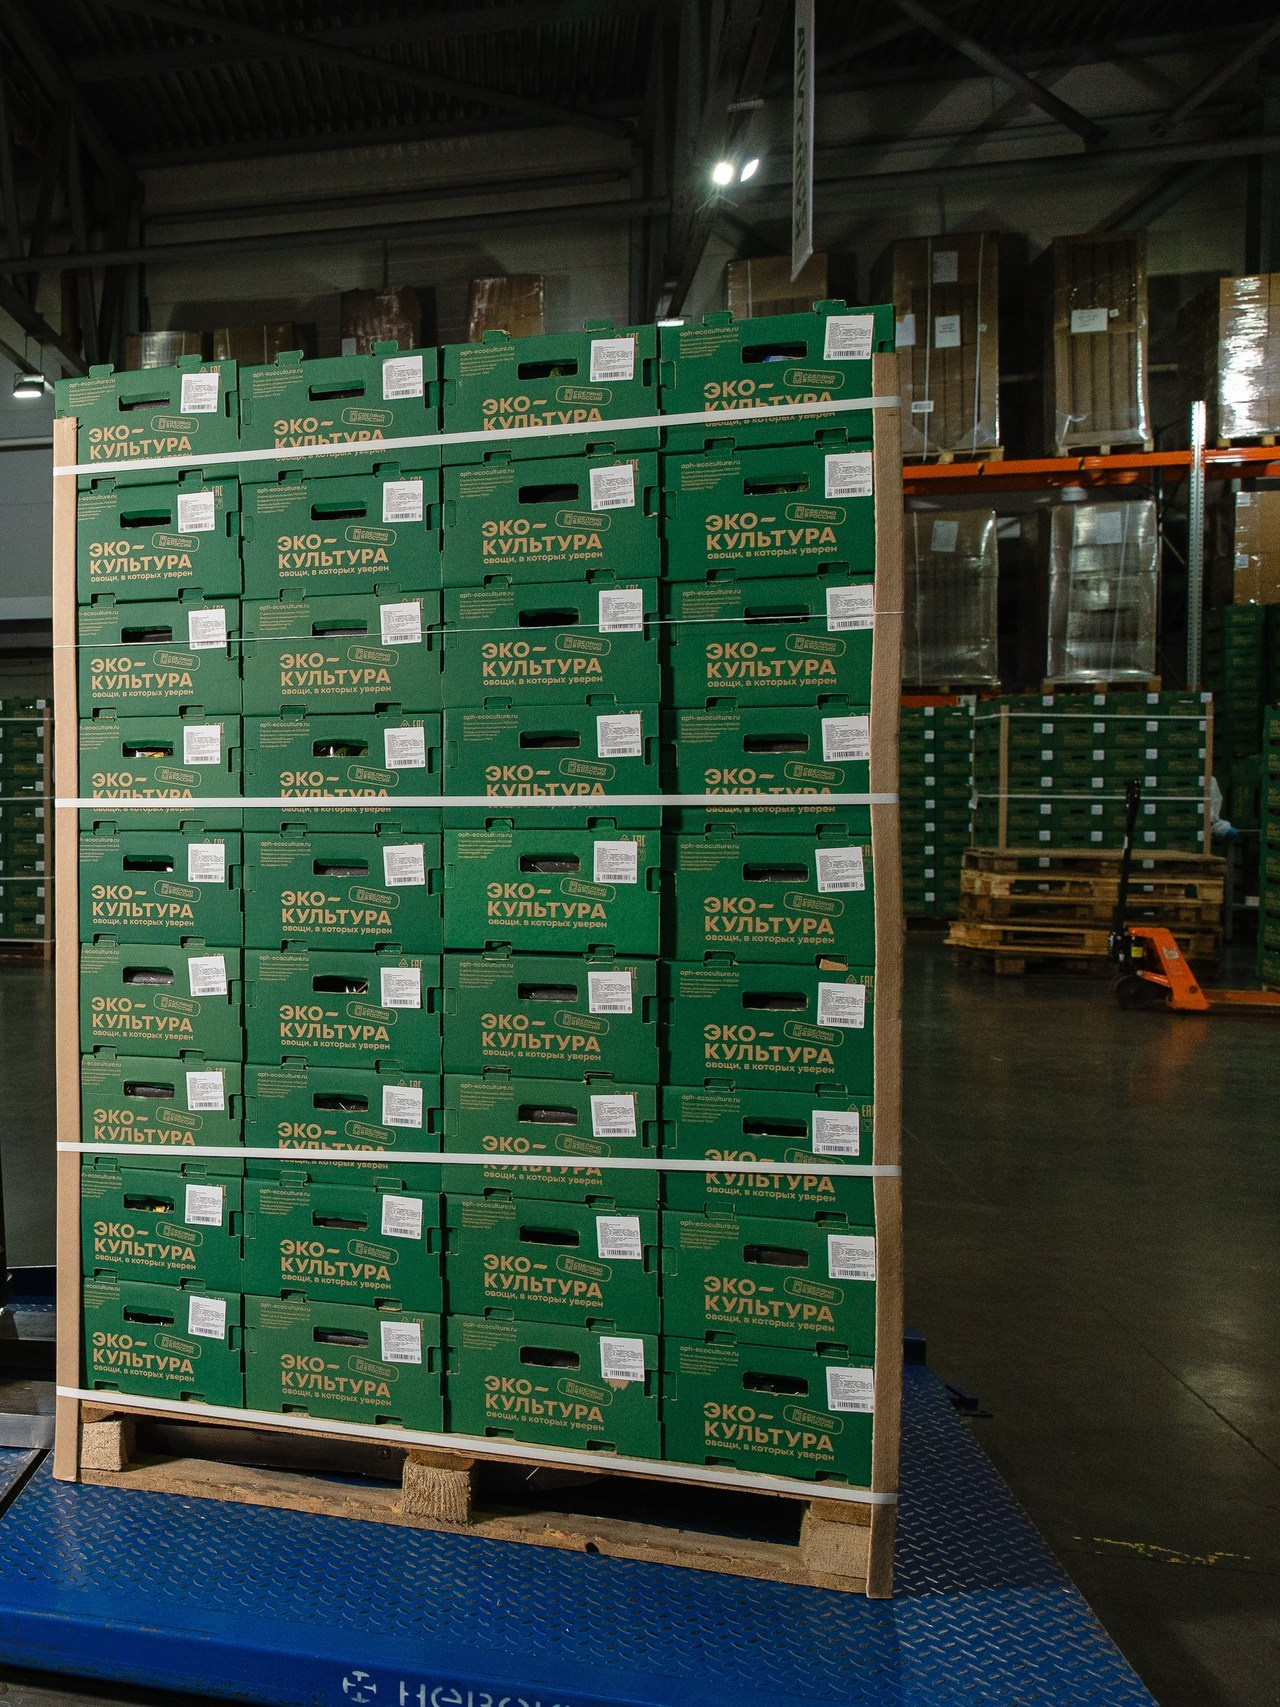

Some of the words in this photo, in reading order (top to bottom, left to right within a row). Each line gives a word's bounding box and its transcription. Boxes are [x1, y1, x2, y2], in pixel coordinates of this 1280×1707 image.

[679, 328, 738, 338] aph-ecoculture.ru
[460, 346, 514, 357] aph-ecoculture.ru
[252, 369, 302, 379] aph-ecoculture.ru
[703, 379, 774, 399] ЭКО-
[482, 396, 547, 415] ЭКО-
[274, 417, 333, 435] ЭКО-
[483, 408, 602, 431] КУЛЬТУРА
[88, 425, 144, 442] ЭКО-
[90, 436, 191, 460] КУЛЬТУРА
[459, 469, 513, 478] aph-ecoculture.ru
[681, 461, 740, 470] aph-ecoculture.ru
[482, 519, 547, 537] ЭКО-
[705, 512, 776, 531] ЭКО-
[277, 534, 337, 551] ЭКО-
[483, 533, 602, 555] КУЛЬТУРА
[707, 527, 836, 550] КУЛЬТУРА
[89, 541, 144, 557] ЭКО-
[707, 551, 743, 559] овощи,
[754, 548, 797, 557] которых
[801, 546, 837, 555] уверен
[90, 554, 191, 574] КУЛЬТУРА
[278, 548, 388, 569] КУЛЬТУРА
[279, 569, 309, 577] овощи,
[319, 567, 355, 575] которых
[358, 565, 389, 573] уверен
[459, 592, 513, 600] aph-ecoculture.ru
[682, 590, 741, 598] aph-ecoculture.ru
[259, 604, 309, 612] aph-ecoculture.ru
[482, 642, 546, 658] ЭКО-
[706, 642, 776, 659] ЭКО-
[91, 657, 146, 673] ЭКО-
[280, 653, 339, 669] ЭКО-
[483, 658, 602, 677] КУЛЬТУРА
[707, 659, 835, 678] КУЛЬТУРА
[92, 672, 193, 689] КУЛЬТУРА
[281, 668, 390, 686] КУЛЬТУРА
[483, 678, 516, 686] овощи,
[527, 677, 566, 685] которых
[569, 676, 602, 684] уверен
[165, 689, 193, 697] уверен
[92, 772, 147, 787] ЭКО-
[280, 771, 339, 787] ЭКО-
[485, 765, 550, 781] ЭКО-
[704, 768, 774, 785] ЭКО-
[486, 782, 605, 796] КУЛЬТУРА
[92, 885, 147, 900] ЭКО-
[281, 890, 341, 906] ЭКО-
[487, 882, 551, 899] ЭКО-
[93, 902, 193, 918] КУЛЬТУРА
[488, 901, 606, 918] КУЛЬТУРА
[704, 897, 774, 914] ЭКО-
[282, 908, 391, 925] КУЛЬТУРА
[705, 916, 834, 934] КУЛЬТУРА
[282, 925, 313, 933] овощи,
[322, 926, 358, 934] которых
[705, 934, 741, 942] овощи,
[752, 936, 795, 944] которых
[91, 996, 146, 1012] ЭКО-
[279, 1005, 338, 1021] ЭКО-
[92, 1013, 192, 1032] КУЛЬТУРА
[481, 1013, 545, 1031] ЭКО-
[280, 1022, 389, 1041] КУЛЬТУРА
[704, 1024, 774, 1042] ЭКО-
[482, 1032, 600, 1052] КУЛЬТУРА
[483, 1049, 515, 1057] овощи,
[526, 1051, 565, 1060] которых
[568, 1054, 601, 1062] уверен
[705, 1043, 834, 1064] КУЛЬТУРА
[681, 1095, 740, 1103] aph-ecoculture.ru
[93, 1109, 148, 1125] ЭКО-
[94, 1125, 195, 1146] КУЛЬТУРА
[278, 1122, 337, 1139] ЭКО-
[482, 1135, 546, 1153] ЭКО-
[706, 1171, 834, 1193] КУЛЬТУРА
[259, 1189, 309, 1197] aph-ecoculture.ru
[94, 1221, 149, 1239] ЭКО-
[680, 1221, 739, 1230] aph-ecoculture.ru
[95, 1238, 195, 1262] КУЛЬТУРА
[280, 1239, 340, 1257] ЭКО-
[281, 1257, 390, 1281] КУЛЬТУРА
[483, 1254, 547, 1273] ЭКО-
[282, 1274, 312, 1283] овощи,
[321, 1277, 357, 1286] которых
[360, 1282, 391, 1290] уверен
[484, 1272, 602, 1298] КУЛЬТУРА
[704, 1276, 774, 1296] ЭКО-
[705, 1295, 834, 1322] КУЛЬТУРА
[705, 1313, 741, 1323] овощи,
[752, 1318, 795, 1328] которых
[798, 1323, 835, 1332] уверен
[92, 1331, 147, 1349] ЭКО-
[93, 1348, 193, 1373] КУЛЬТУРА
[679, 1347, 738, 1358] aph-ecoculture.ru
[280, 1354, 340, 1372] ЭКО-
[281, 1371, 390, 1397] КУЛЬТУРА
[484, 1375, 548, 1395] ЭКО-
[486, 1393, 603, 1422] КУЛЬТУРА
[703, 1402, 774, 1423] ЭКО-
[486, 1411, 518, 1421] овощи,
[529, 1416, 567, 1427] которых
[571, 1422, 604, 1431] уверен
[705, 1420, 833, 1451] КУЛЬТУРА
[705, 1439, 741, 1450] овощи,
[752, 1445, 794, 1456] которых
[798, 1451, 834, 1461] уверен
